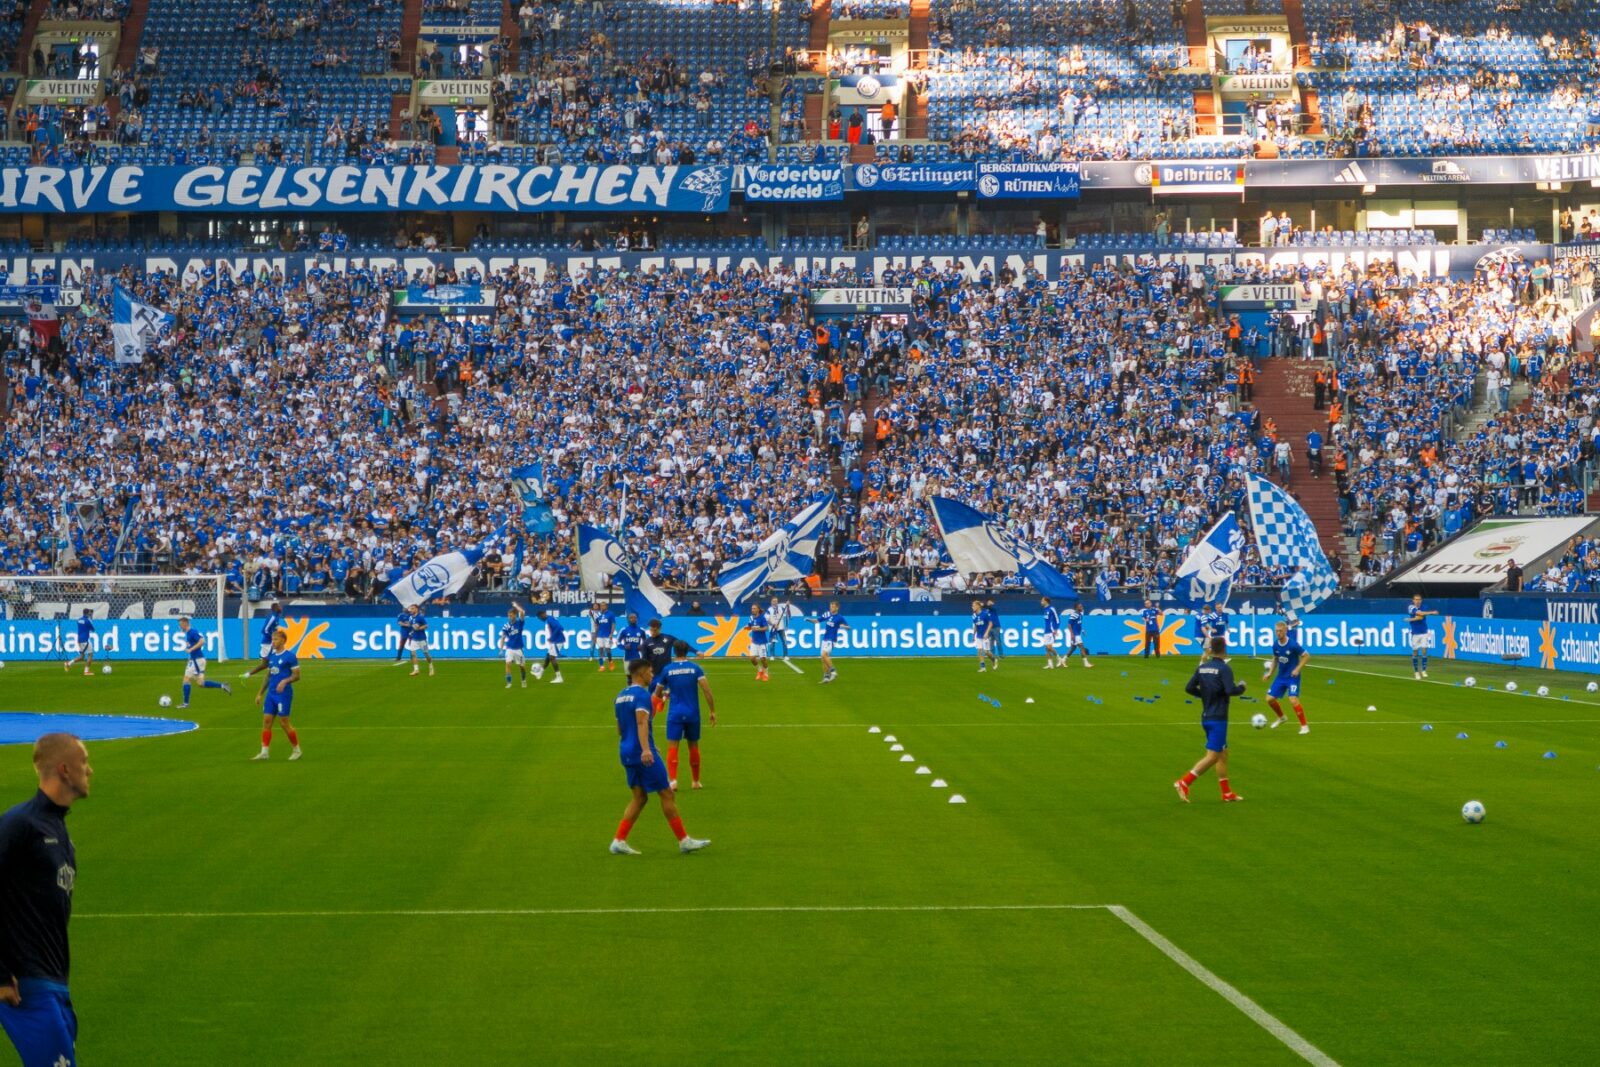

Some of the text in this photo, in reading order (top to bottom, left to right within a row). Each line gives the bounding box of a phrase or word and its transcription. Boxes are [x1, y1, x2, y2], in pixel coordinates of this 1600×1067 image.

[48, 83, 97, 95] VELTINS
[440, 83, 489, 95] VELTINS
[1241, 78, 1289, 90] VELTINS
[1163, 167, 1233, 182] Delbrück
[173, 165, 675, 212] GELSENKIRCHEN
[746, 183, 823, 199] Coesfeld
[1004, 178, 1053, 192] RÜTHEN
[845, 290, 905, 304] VELTINS
[1253, 287, 1296, 300] VELTI
[1419, 563, 1523, 574] VELTIN
[129, 623, 219, 652] reisn
[352, 624, 551, 652] schuinslnd
[1208, 621, 1395, 649] chainsland
[1459, 625, 1504, 655] schauinsland
[1505, 627, 1530, 658] reisen
